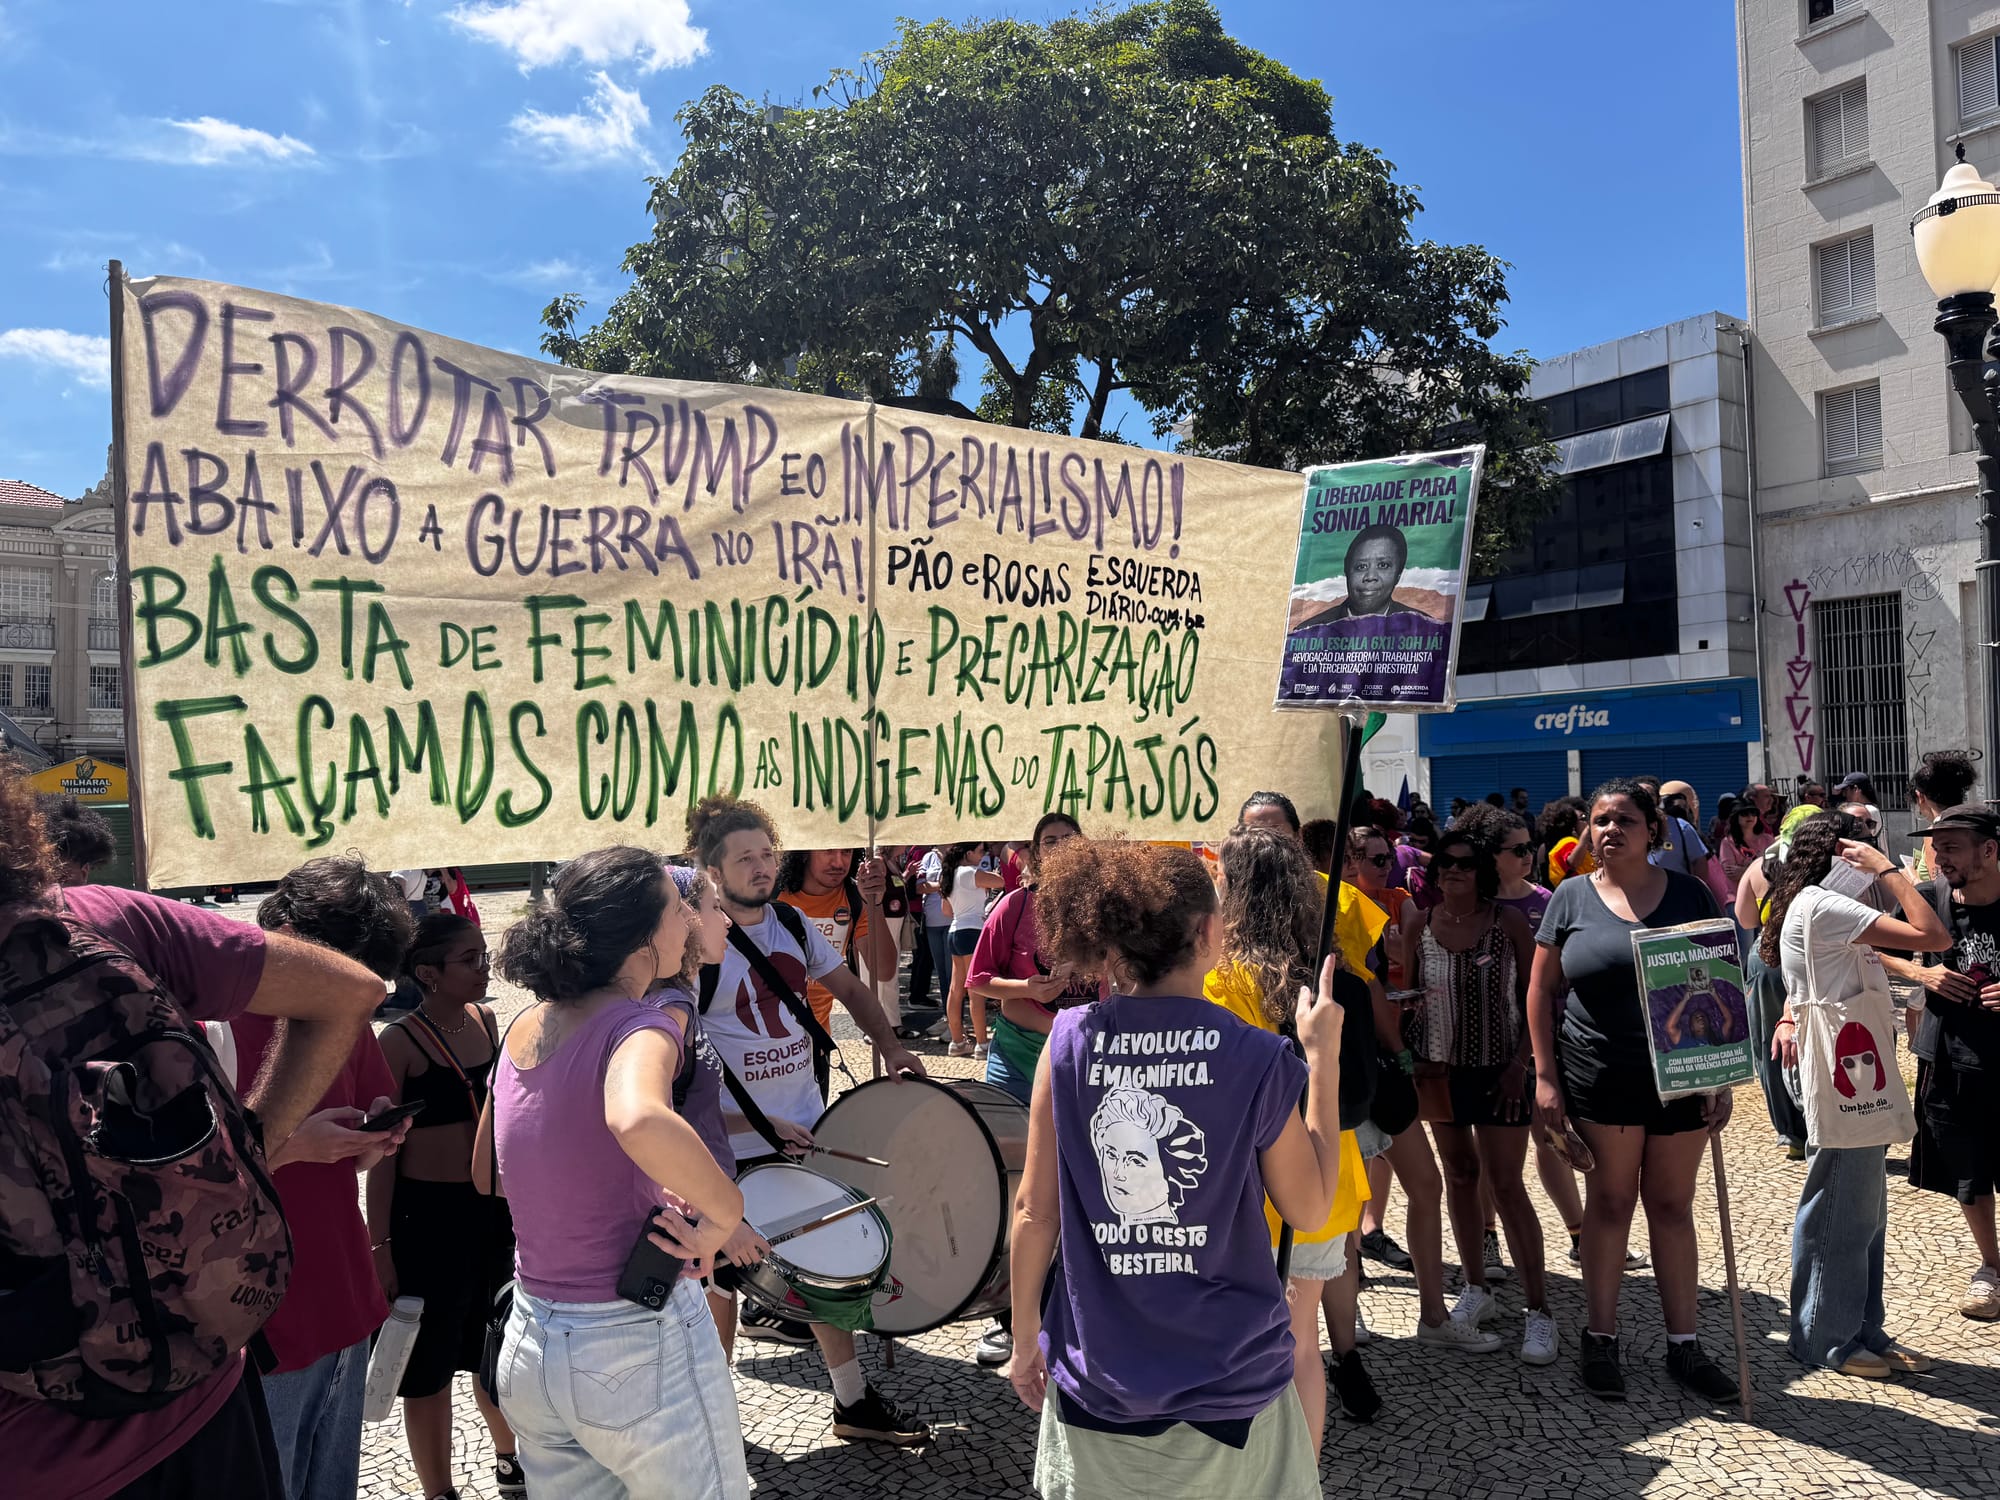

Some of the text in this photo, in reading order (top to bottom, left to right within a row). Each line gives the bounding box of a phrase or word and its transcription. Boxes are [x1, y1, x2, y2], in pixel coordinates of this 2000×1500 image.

[138, 290, 556, 486] DERROTAR
[577, 387, 778, 514] TRUMP
[840, 422, 1185, 559] IMPERIALISMO!
[1315, 475, 1457, 508] LIBERDADE PARA
[131, 441, 867, 603] ABAIXO A GUERRA NO IRÃ!
[1311, 499, 1456, 534] SONIA MARIA!
[887, 536, 954, 594] PÃO
[1086, 554, 1202, 603] ESQUERDA
[130, 553, 1201, 723] BASTA DE FEMINICÍDIO E PRECARIZAÇÃO
[1290, 631, 1443, 651] FIM DA ESCALA 6X1! 30H JÁ!
[1292, 651, 1433, 665] REVOGAÇÃO DA REFORMA TRABALHISTA
[1303, 662, 1419, 675] E DA TERCEIRIZAÇÃO IRRESTRITA!
[1534, 704, 1610, 735] crefisa
[154, 689, 1220, 849] FAÇAMOS COMO AS INDÍGENAS DO TAPAJÓS
[61, 778, 112, 787] MILHARAL
[65, 786, 107, 795] URBANO
[1646, 943, 1735, 968] JUSTIÇA MACHISTA!
[1665, 1065, 1686, 1075] VÍTIMA
[1694, 1060, 1722, 1071] VIOLÊNCIA
[1668, 1058, 1682, 1066] COM
[1707, 1053, 1720, 1062] COM
[1720, 1050, 1734, 1059] CADA
[1734, 1046, 1744, 1056] MÃE
[1088, 1058, 1215, 1089] É MAGNÍFICA.
[1839, 1098, 1888, 1113] Um belo dia
[1135, 1224, 1148, 1244] O
[1152, 1225, 1208, 1247] RESTO
[1110, 1252, 1199, 1276] BESTEIRA.
